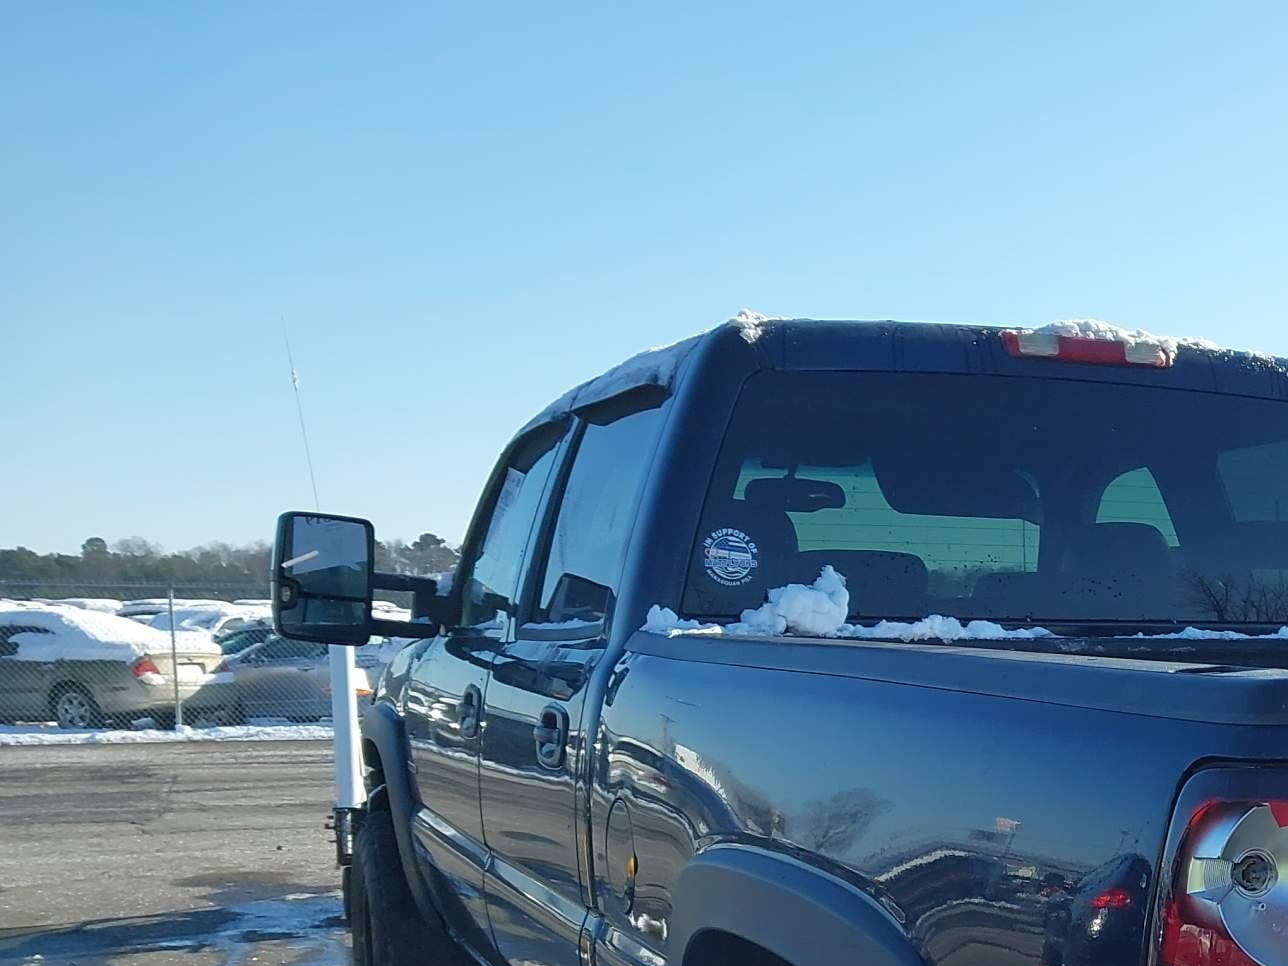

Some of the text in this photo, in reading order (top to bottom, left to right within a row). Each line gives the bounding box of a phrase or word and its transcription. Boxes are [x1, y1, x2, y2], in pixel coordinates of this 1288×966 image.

[704, 528, 758, 554] IN SUPPORT OF
